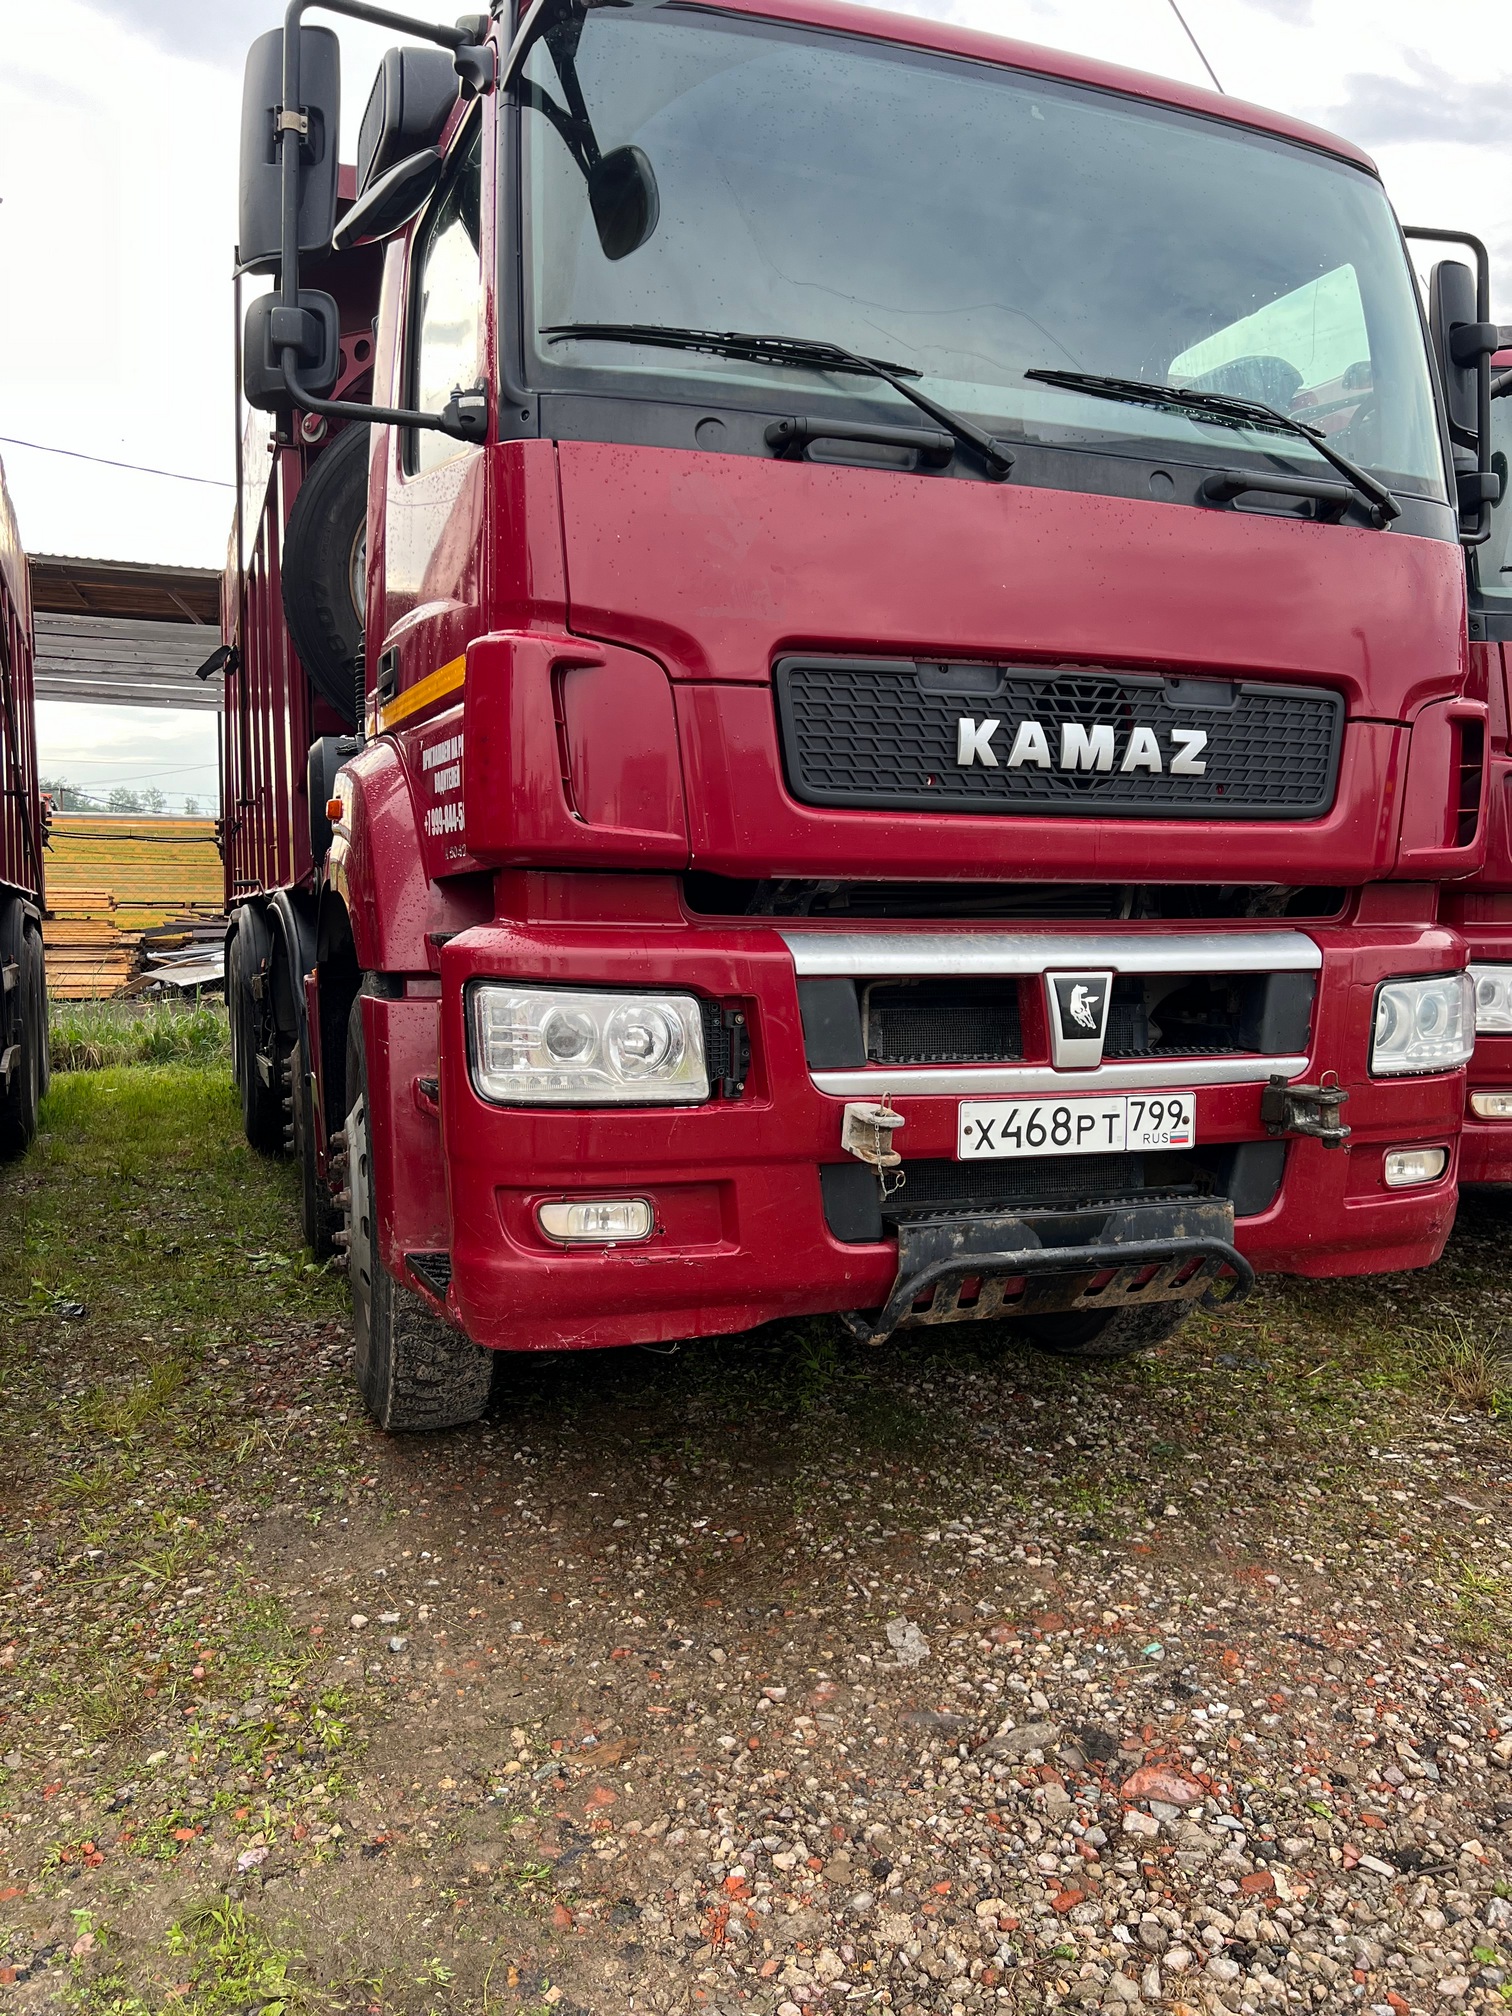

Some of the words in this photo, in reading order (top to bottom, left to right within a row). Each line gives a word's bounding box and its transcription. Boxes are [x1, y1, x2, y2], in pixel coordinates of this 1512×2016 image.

[956, 717, 1209, 776] KAMAZ
[974, 1106, 1121, 1151] Х468РТ
[1130, 1099, 1183, 1132] 799
[1143, 1132, 1169, 1144] RUS
